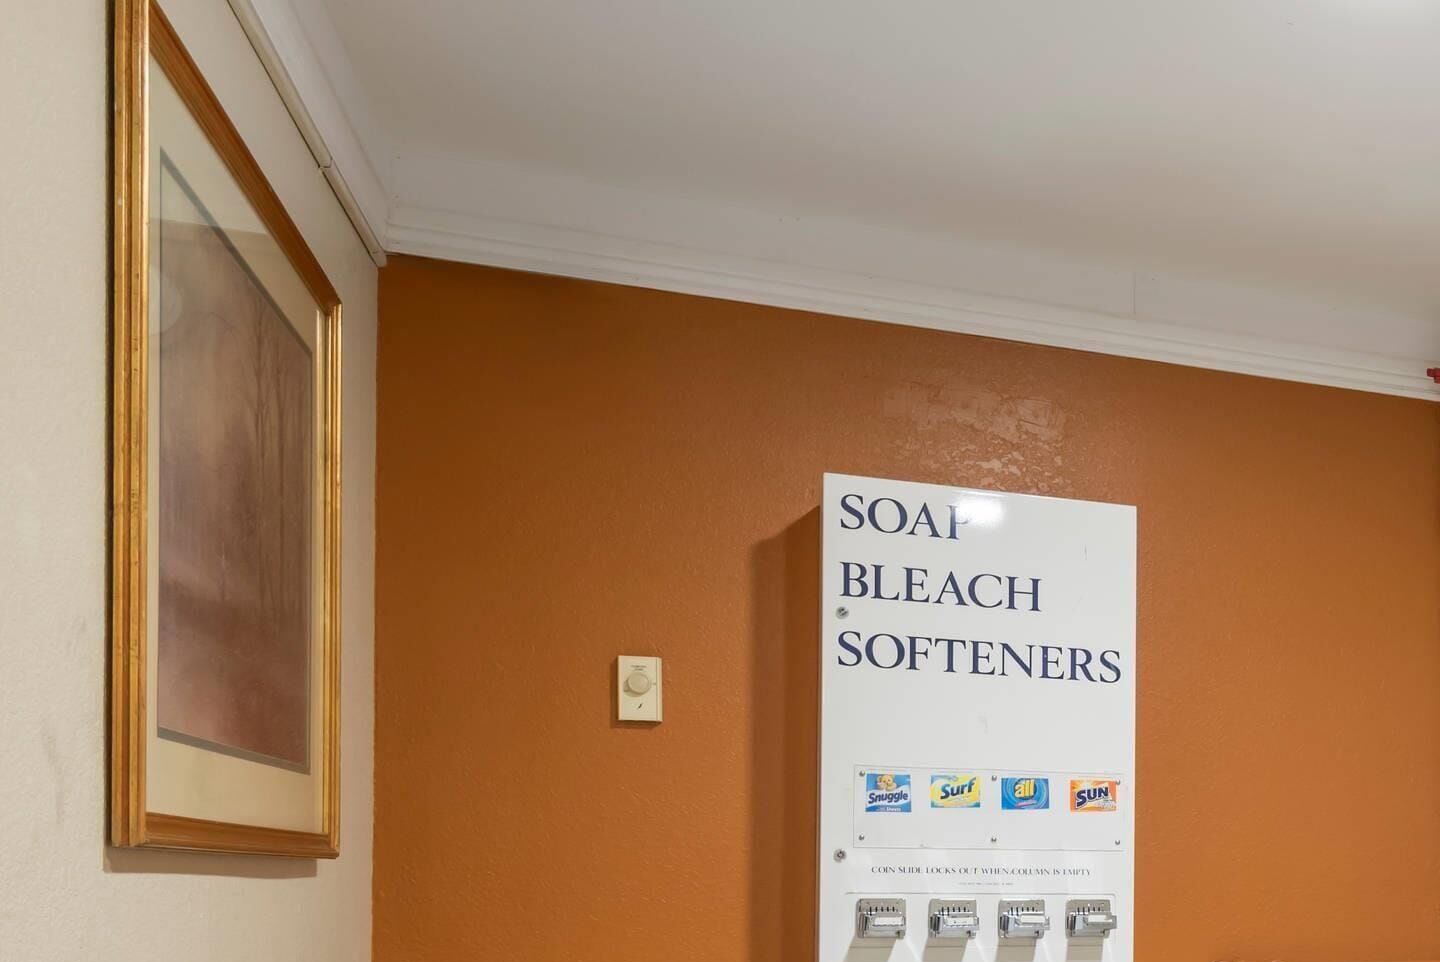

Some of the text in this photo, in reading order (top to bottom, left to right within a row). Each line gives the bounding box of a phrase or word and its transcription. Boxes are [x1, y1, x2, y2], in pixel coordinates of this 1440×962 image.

[839, 561, 1042, 612] BLEACH
[837, 630, 1121, 684] SOFTENERS
[868, 790, 908, 804] Snuggle
[940, 777, 976, 800] Surf
[1014, 779, 1034, 798] all
[1076, 786, 1109, 808] SUN
[871, 866, 896, 874] COIN
[898, 866, 921, 874] SLIDE
[926, 866, 956, 875] LOCKS
[959, 867, 978, 875] OUT
[981, 867, 1009, 875] WHEN
[1010, 868, 1050, 876] COLUMN
[1062, 868, 1092, 876] EMPTY
